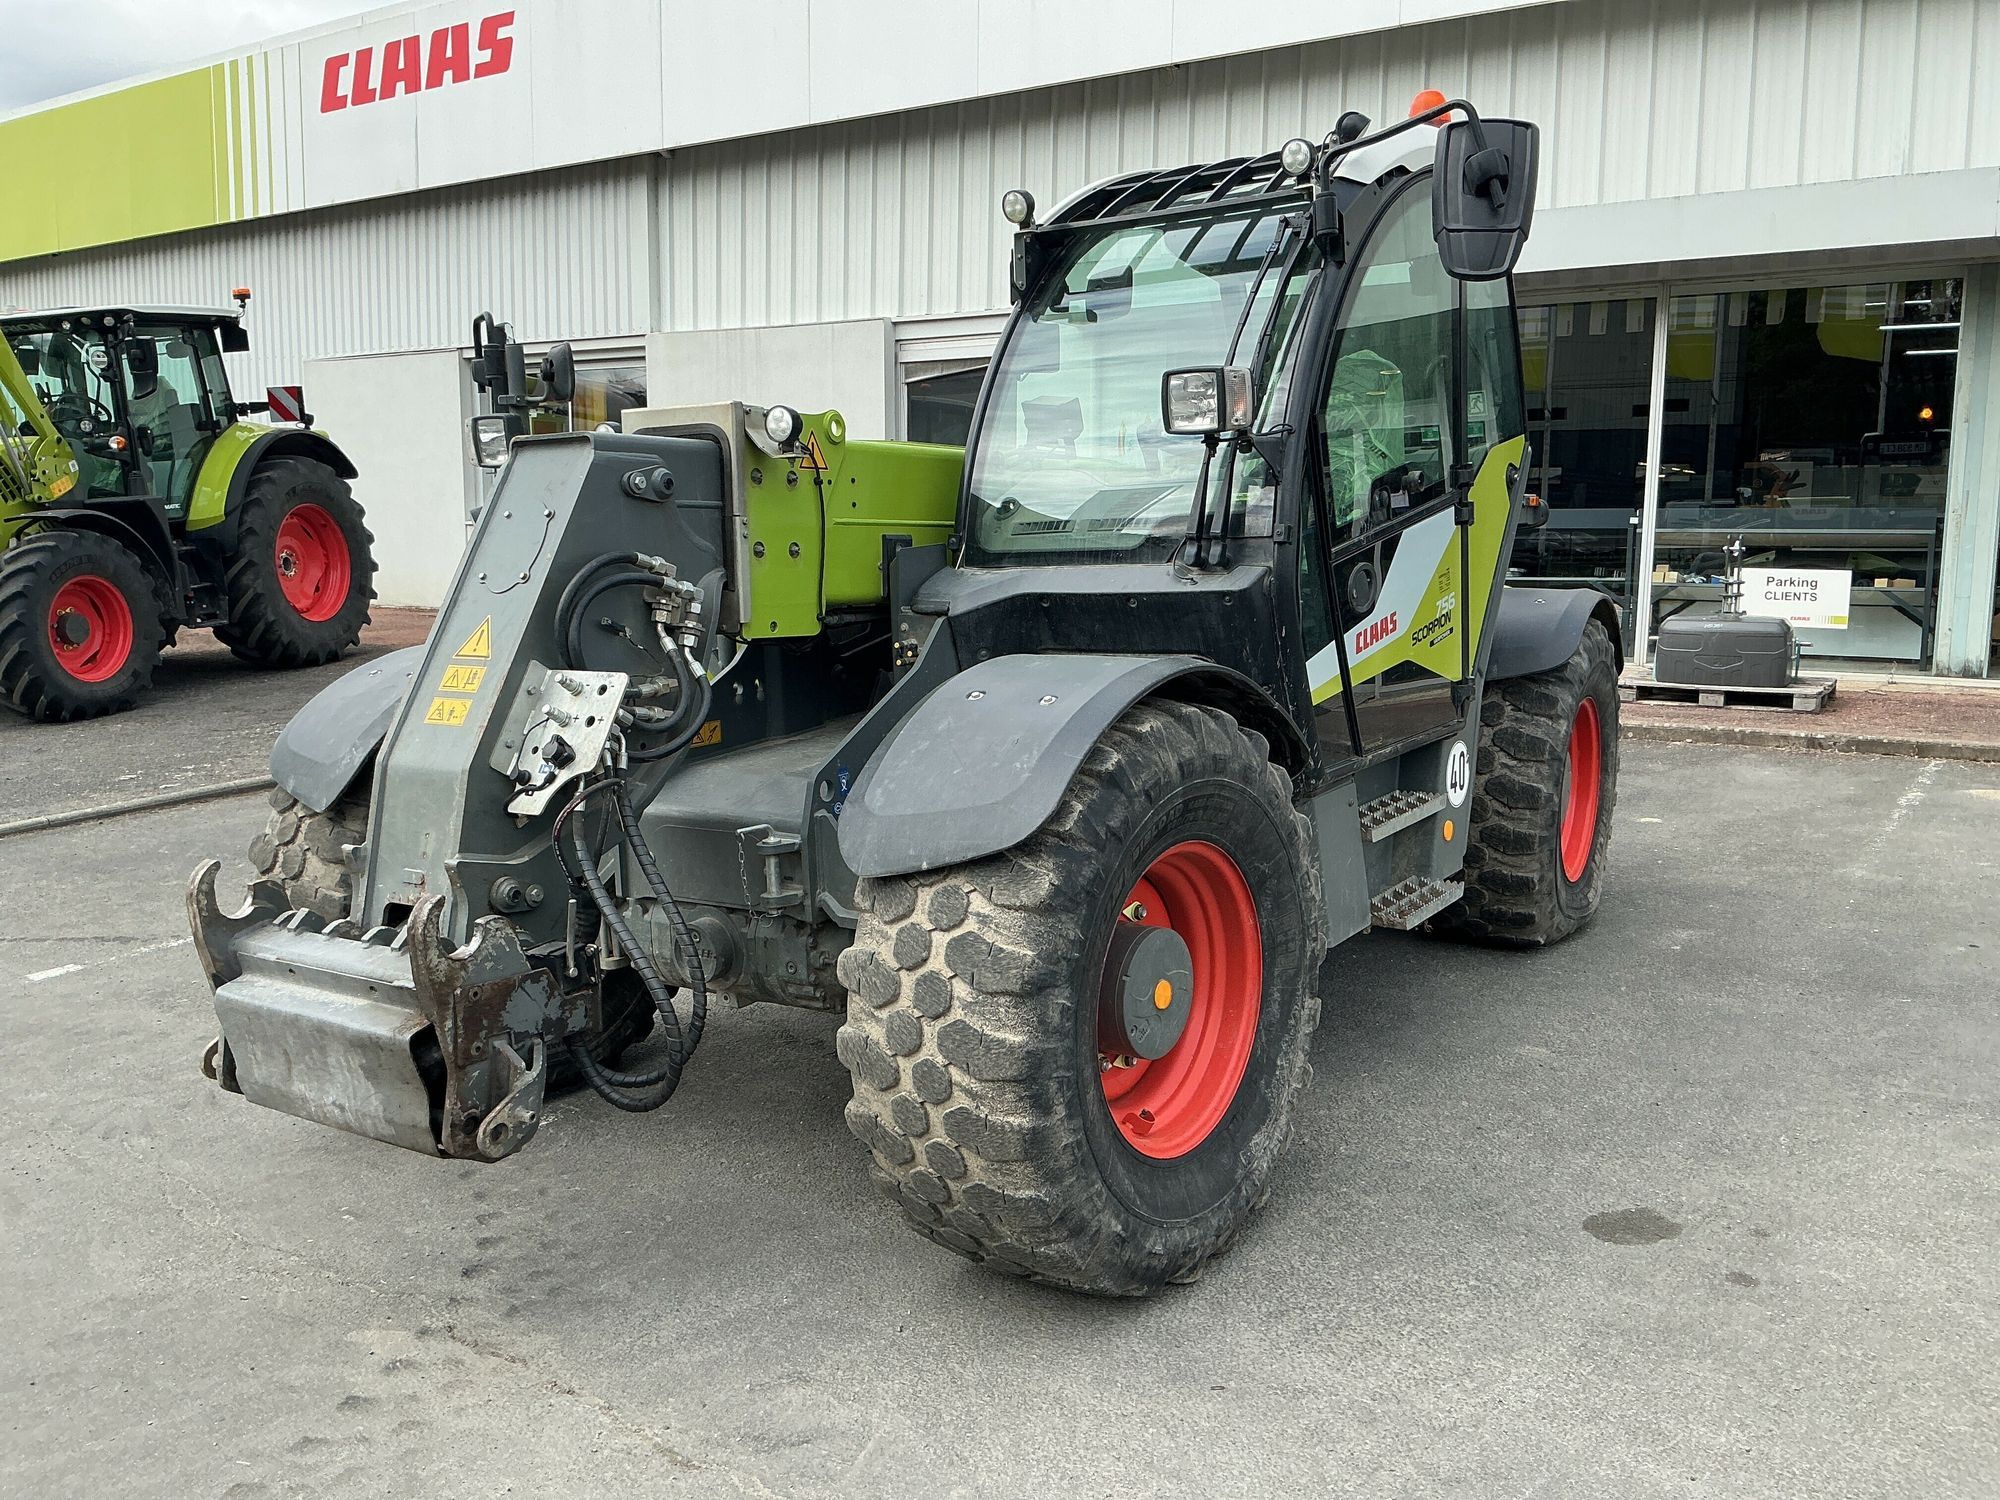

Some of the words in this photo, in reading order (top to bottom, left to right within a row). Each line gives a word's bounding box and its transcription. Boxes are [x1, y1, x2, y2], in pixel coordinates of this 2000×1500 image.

[320, 10, 515, 114] CLAAS
[1764, 590, 1818, 602] CLIENTS
[1766, 576, 1818, 590] Parking
[1436, 592, 1456, 618] 756
[1355, 610, 1397, 655] CLAAS
[1411, 609, 1452, 647] SCORPION
[1450, 750, 1466, 794] 40
